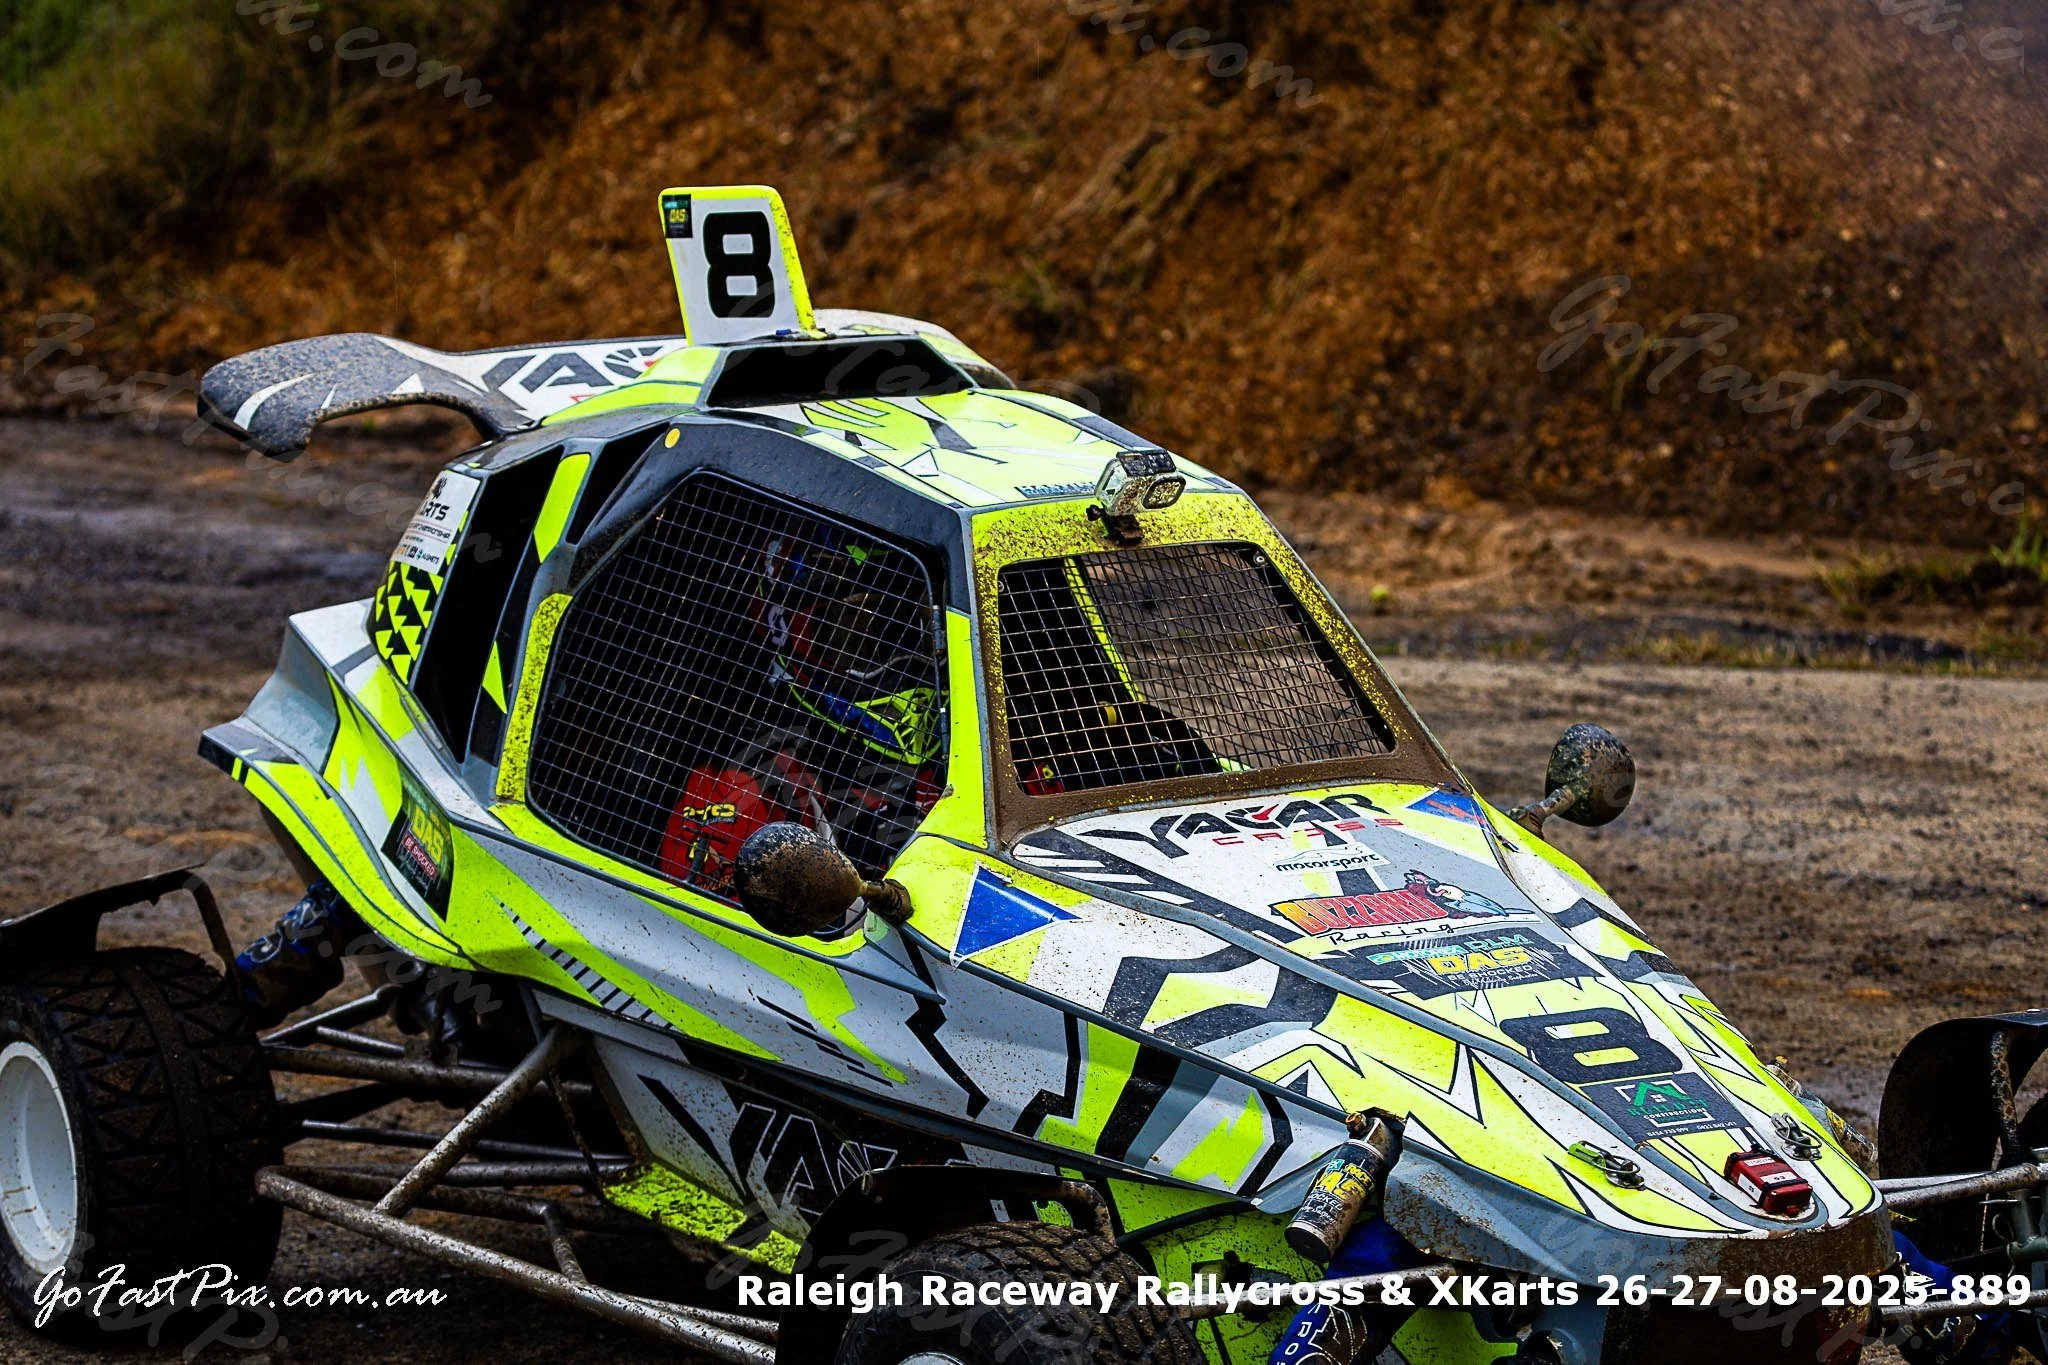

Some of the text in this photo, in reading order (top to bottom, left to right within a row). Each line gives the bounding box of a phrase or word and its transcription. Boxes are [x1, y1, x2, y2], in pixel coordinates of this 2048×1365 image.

[702, 210, 776, 319] 8
[411, 805, 445, 865] DAS
[1077, 793, 1390, 859] YACAR
[1276, 852, 1381, 873] motorsport
[1272, 888, 1450, 936] BUZZARD
[1317, 923, 1456, 946] Racing
[1428, 946, 1532, 976] DAS
[1470, 964, 1534, 981] SHOCKED
[1499, 1006, 1684, 1085] 8
[1643, 1107, 1709, 1120] CONSTRUCTIONS
